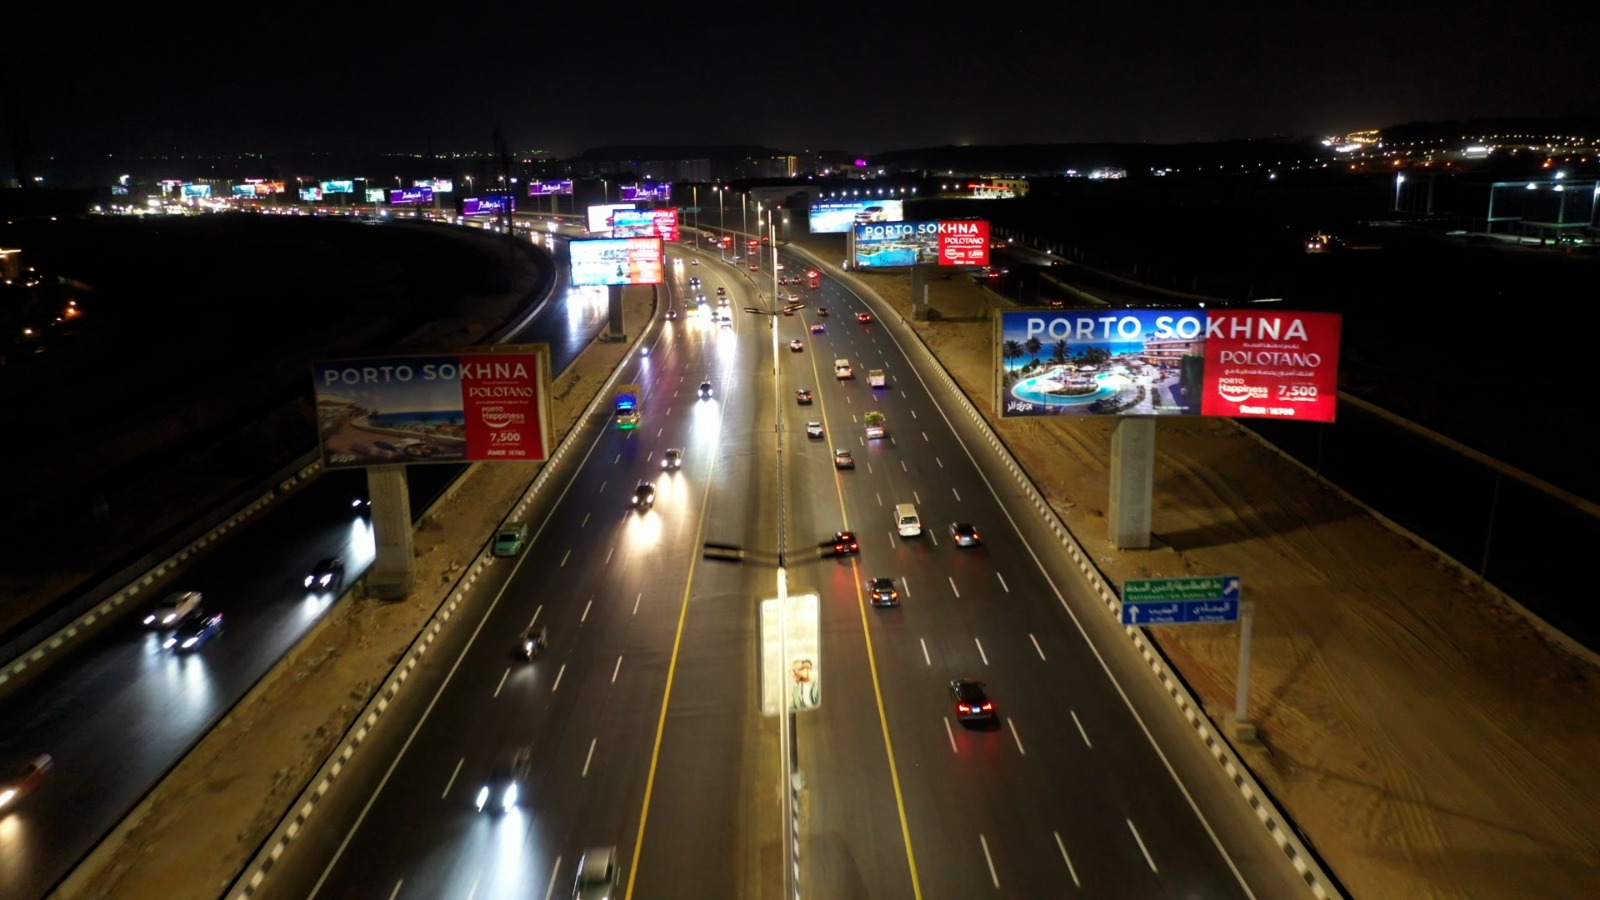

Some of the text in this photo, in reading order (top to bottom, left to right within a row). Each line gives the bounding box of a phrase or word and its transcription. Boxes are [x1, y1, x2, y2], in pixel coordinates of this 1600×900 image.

[865, 223, 979, 236] PORTO SOKHNA
[1026, 316, 1309, 342] PORTO SOKHNA
[1220, 350, 1321, 368] POLOTANO
[324, 362, 529, 385] PORTO SOKHNA
[469, 387, 533, 397] POLOTANO
[1218, 384, 1268, 394] Happiness
[1278, 385, 1317, 397] 7,500
[482, 412, 525, 420] Happiness
[490, 433, 520, 442] 7,500
